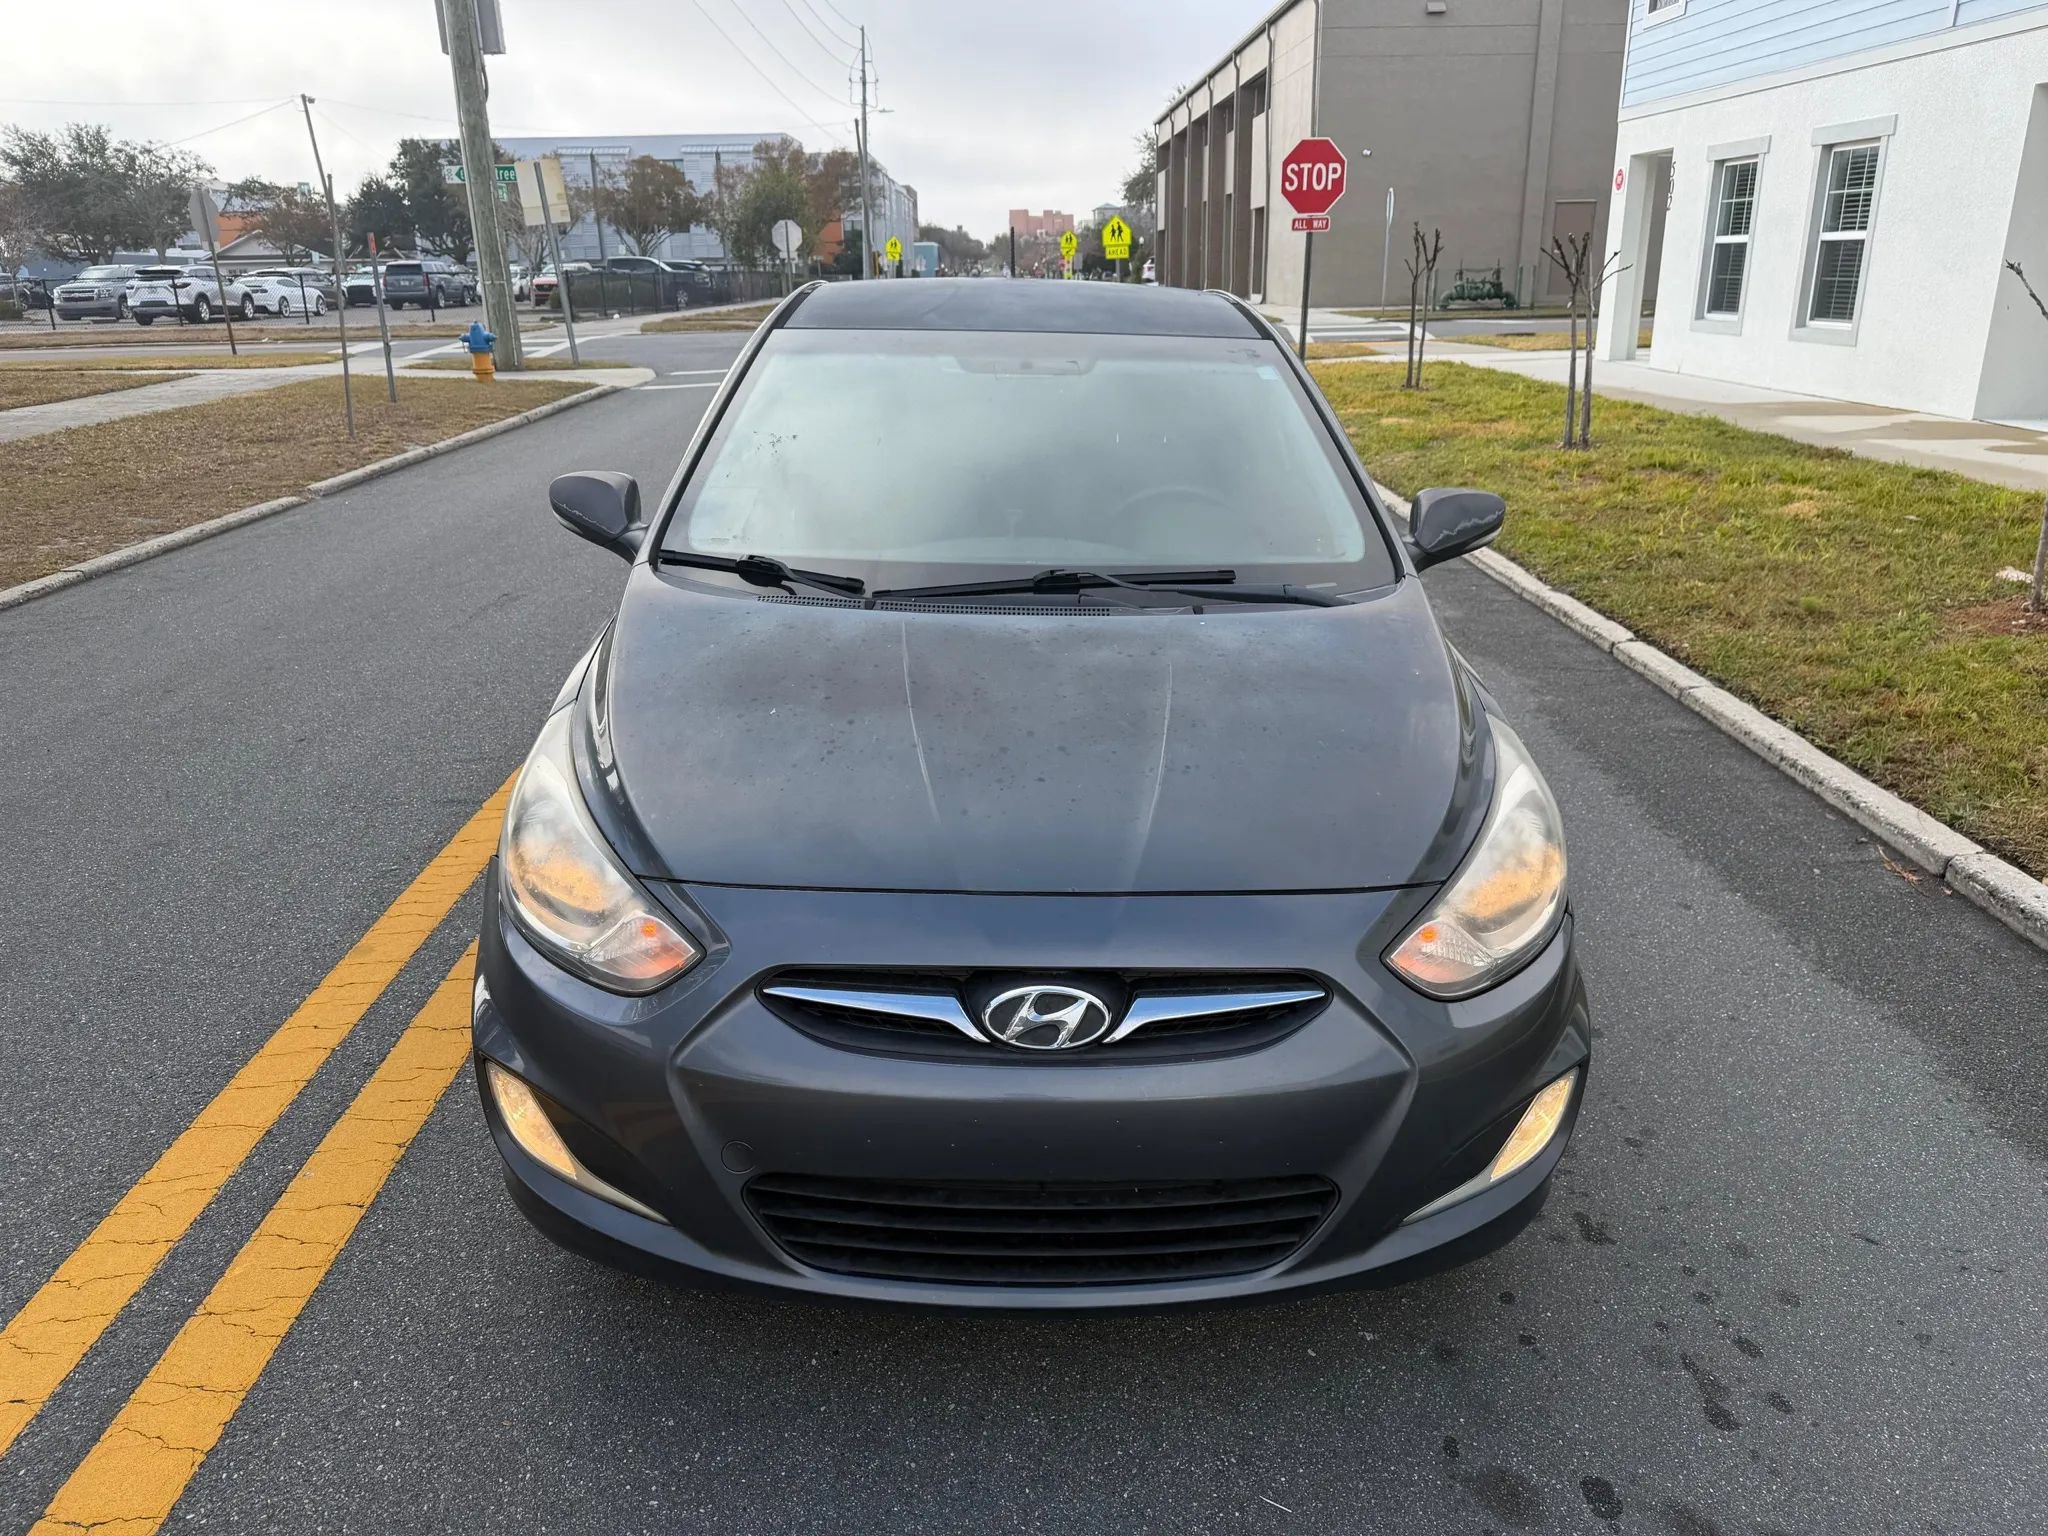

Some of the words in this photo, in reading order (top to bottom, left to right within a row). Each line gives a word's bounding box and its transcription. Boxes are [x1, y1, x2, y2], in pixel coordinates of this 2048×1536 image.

[495, 167, 515, 180] tree
[1284, 162, 1342, 192] STOP
[1293, 219, 1308, 229] ALL
[1312, 219, 1327, 229] WAY
[1108, 248, 1127, 256] AHEAD
